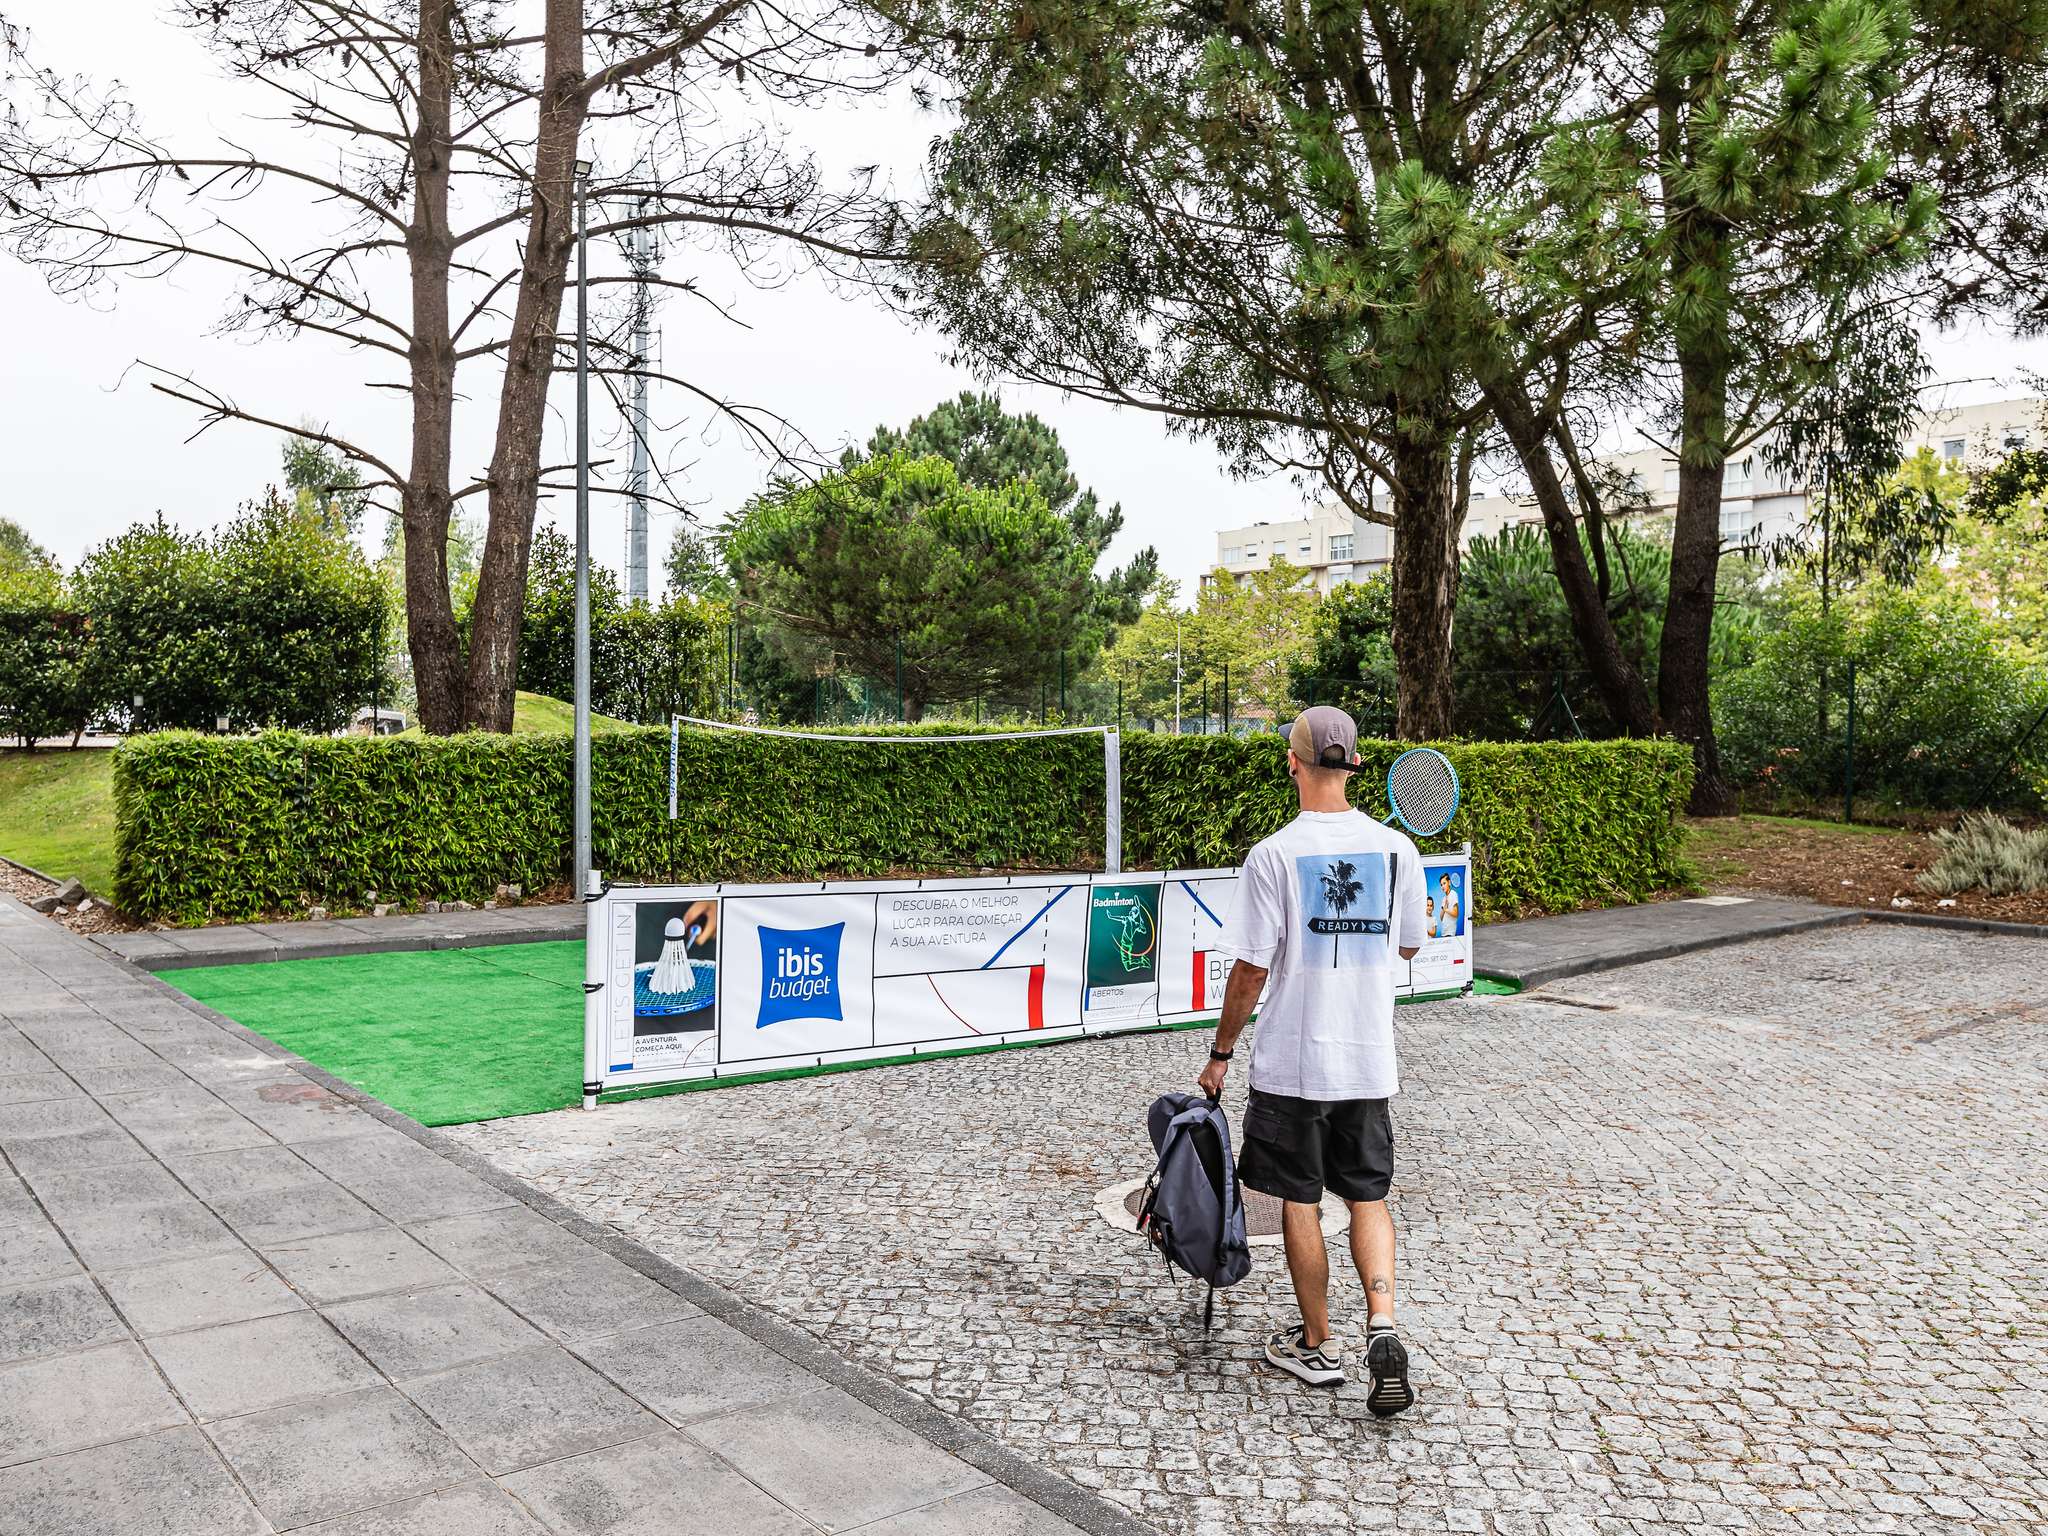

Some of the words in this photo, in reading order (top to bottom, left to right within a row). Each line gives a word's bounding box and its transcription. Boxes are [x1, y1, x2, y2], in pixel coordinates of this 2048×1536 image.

[892, 898, 957, 912] DESCUBRA
[959, 897, 969, 909] O
[971, 895, 1019, 908] MELHOR
[1093, 897, 1134, 908] Badminton
[616, 914, 632, 936] IN
[892, 916, 931, 930] LUGAR
[933, 915, 964, 928] PARA
[967, 913, 1023, 927] COMEÇAR
[1318, 921, 1358, 931] READY
[890, 937, 899, 948] A
[901, 935, 926, 947] SUA
[927, 932, 987, 946] AVENTURA
[615, 944, 631, 988] GET
[778, 946, 824, 978] ibis
[769, 976, 832, 1001] budget
[1092, 988, 1124, 998] ABERTOS
[641, 1035, 678, 1044] AVENTURA
[635, 1044, 664, 1053] COMEÇA
